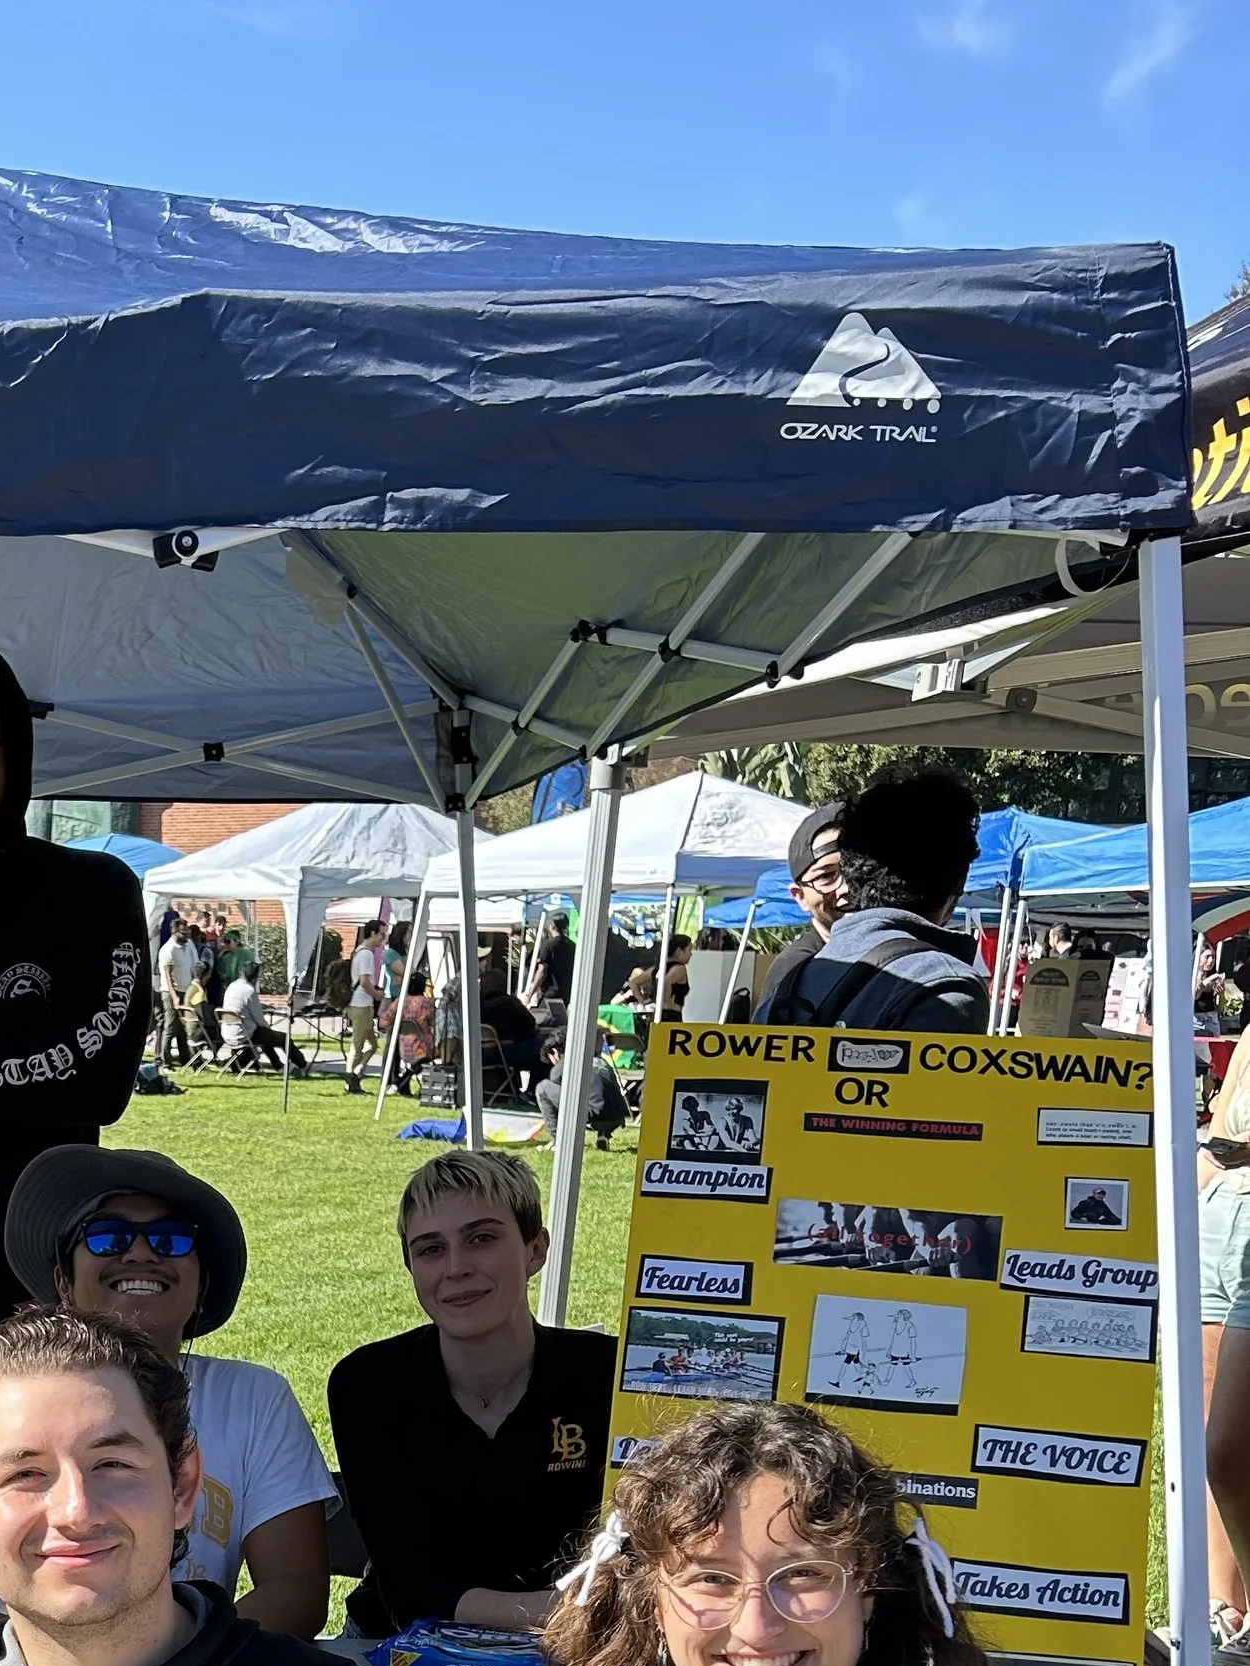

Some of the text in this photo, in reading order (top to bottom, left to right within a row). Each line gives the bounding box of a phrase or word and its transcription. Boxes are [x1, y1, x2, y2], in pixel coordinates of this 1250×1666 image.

[780, 422, 864, 441] OZARK
[667, 1029, 1153, 1092] ROWER COXSWAIN?
[835, 1077, 890, 1108] OR
[811, 1116, 980, 1136] THE WINNING FORMULA
[644, 1162, 767, 1193] Champion
[643, 1266, 742, 1296] Fearless
[1005, 1254, 1158, 1294] Leads Group
[551, 1417, 586, 1461] LB
[982, 1438, 1132, 1476] THE VOICE
[956, 1571, 1121, 1609] Takes Action
